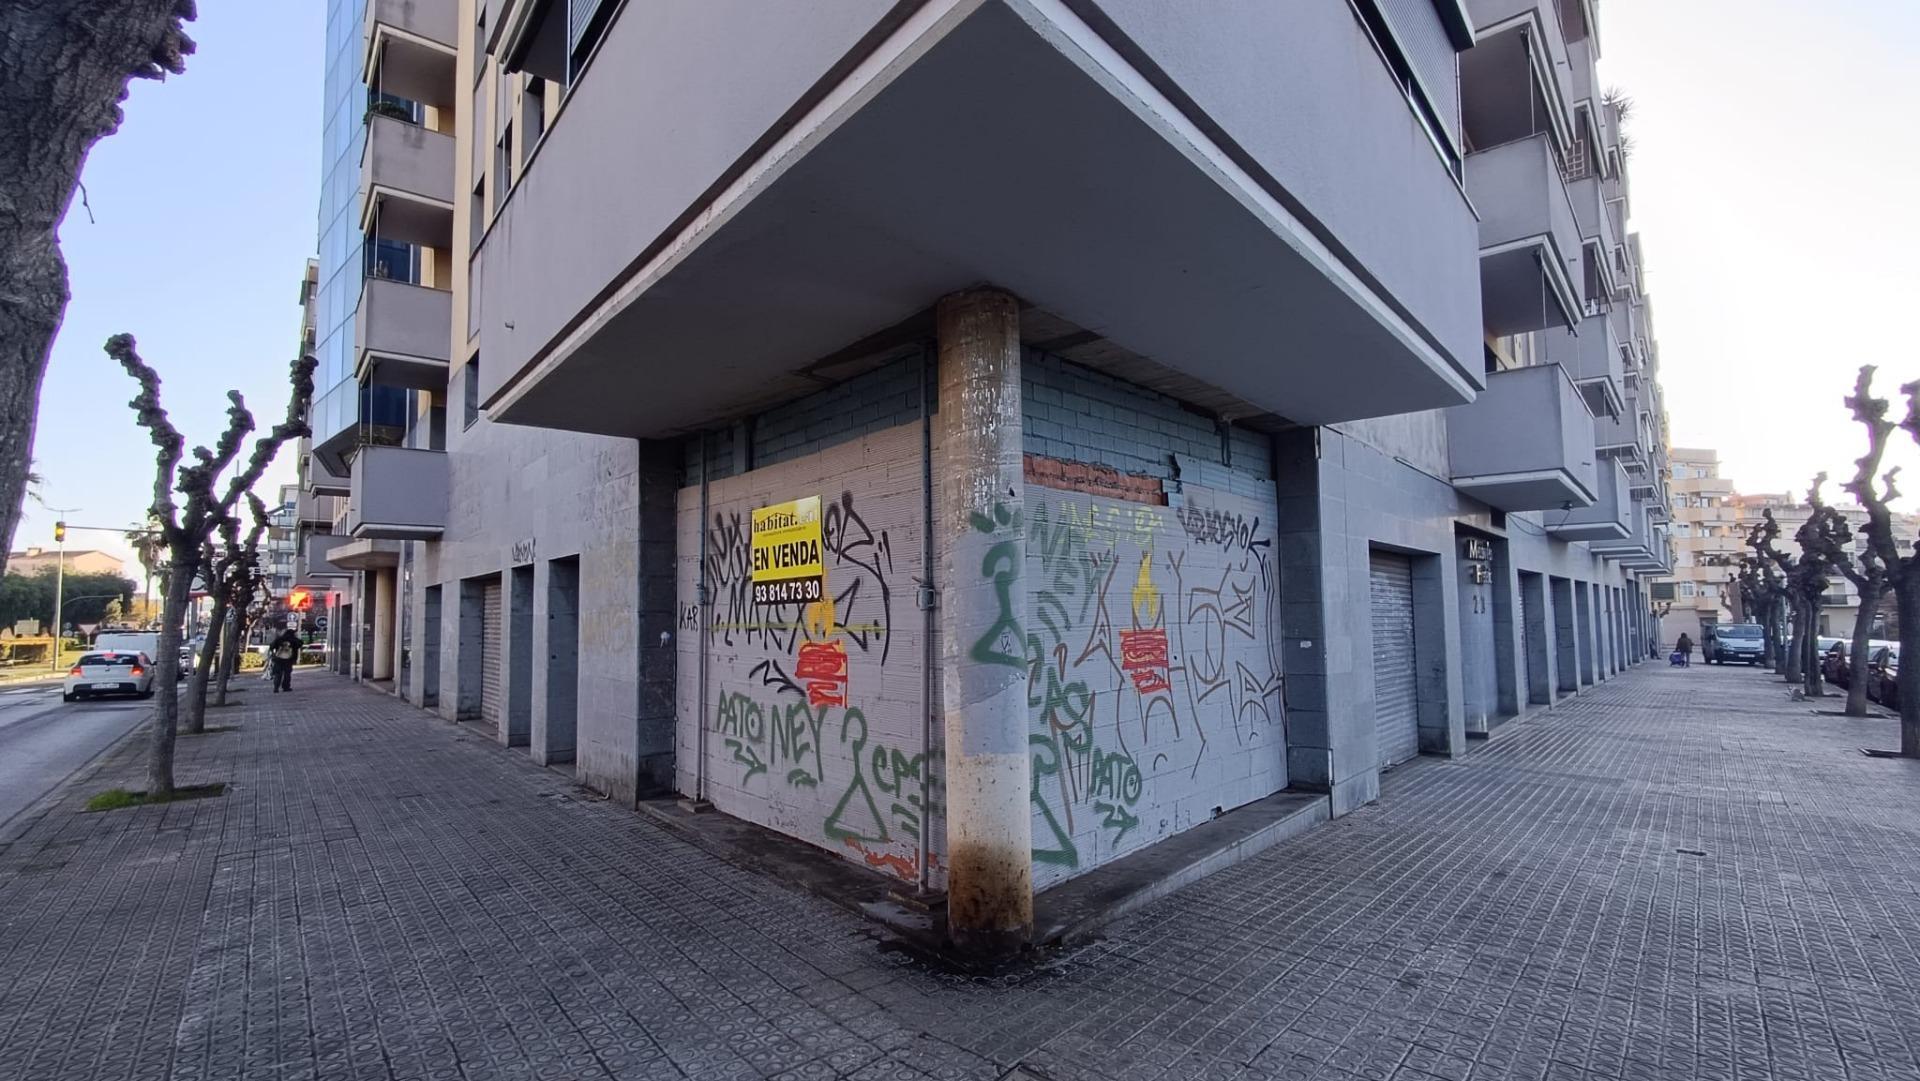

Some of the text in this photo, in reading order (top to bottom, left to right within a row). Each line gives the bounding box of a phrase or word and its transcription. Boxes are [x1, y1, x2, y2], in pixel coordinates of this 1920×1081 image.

[753, 512, 798, 533] habitat.
[753, 539, 820, 571] EN VENDA
[755, 580, 820, 602] 93 814 73 30
